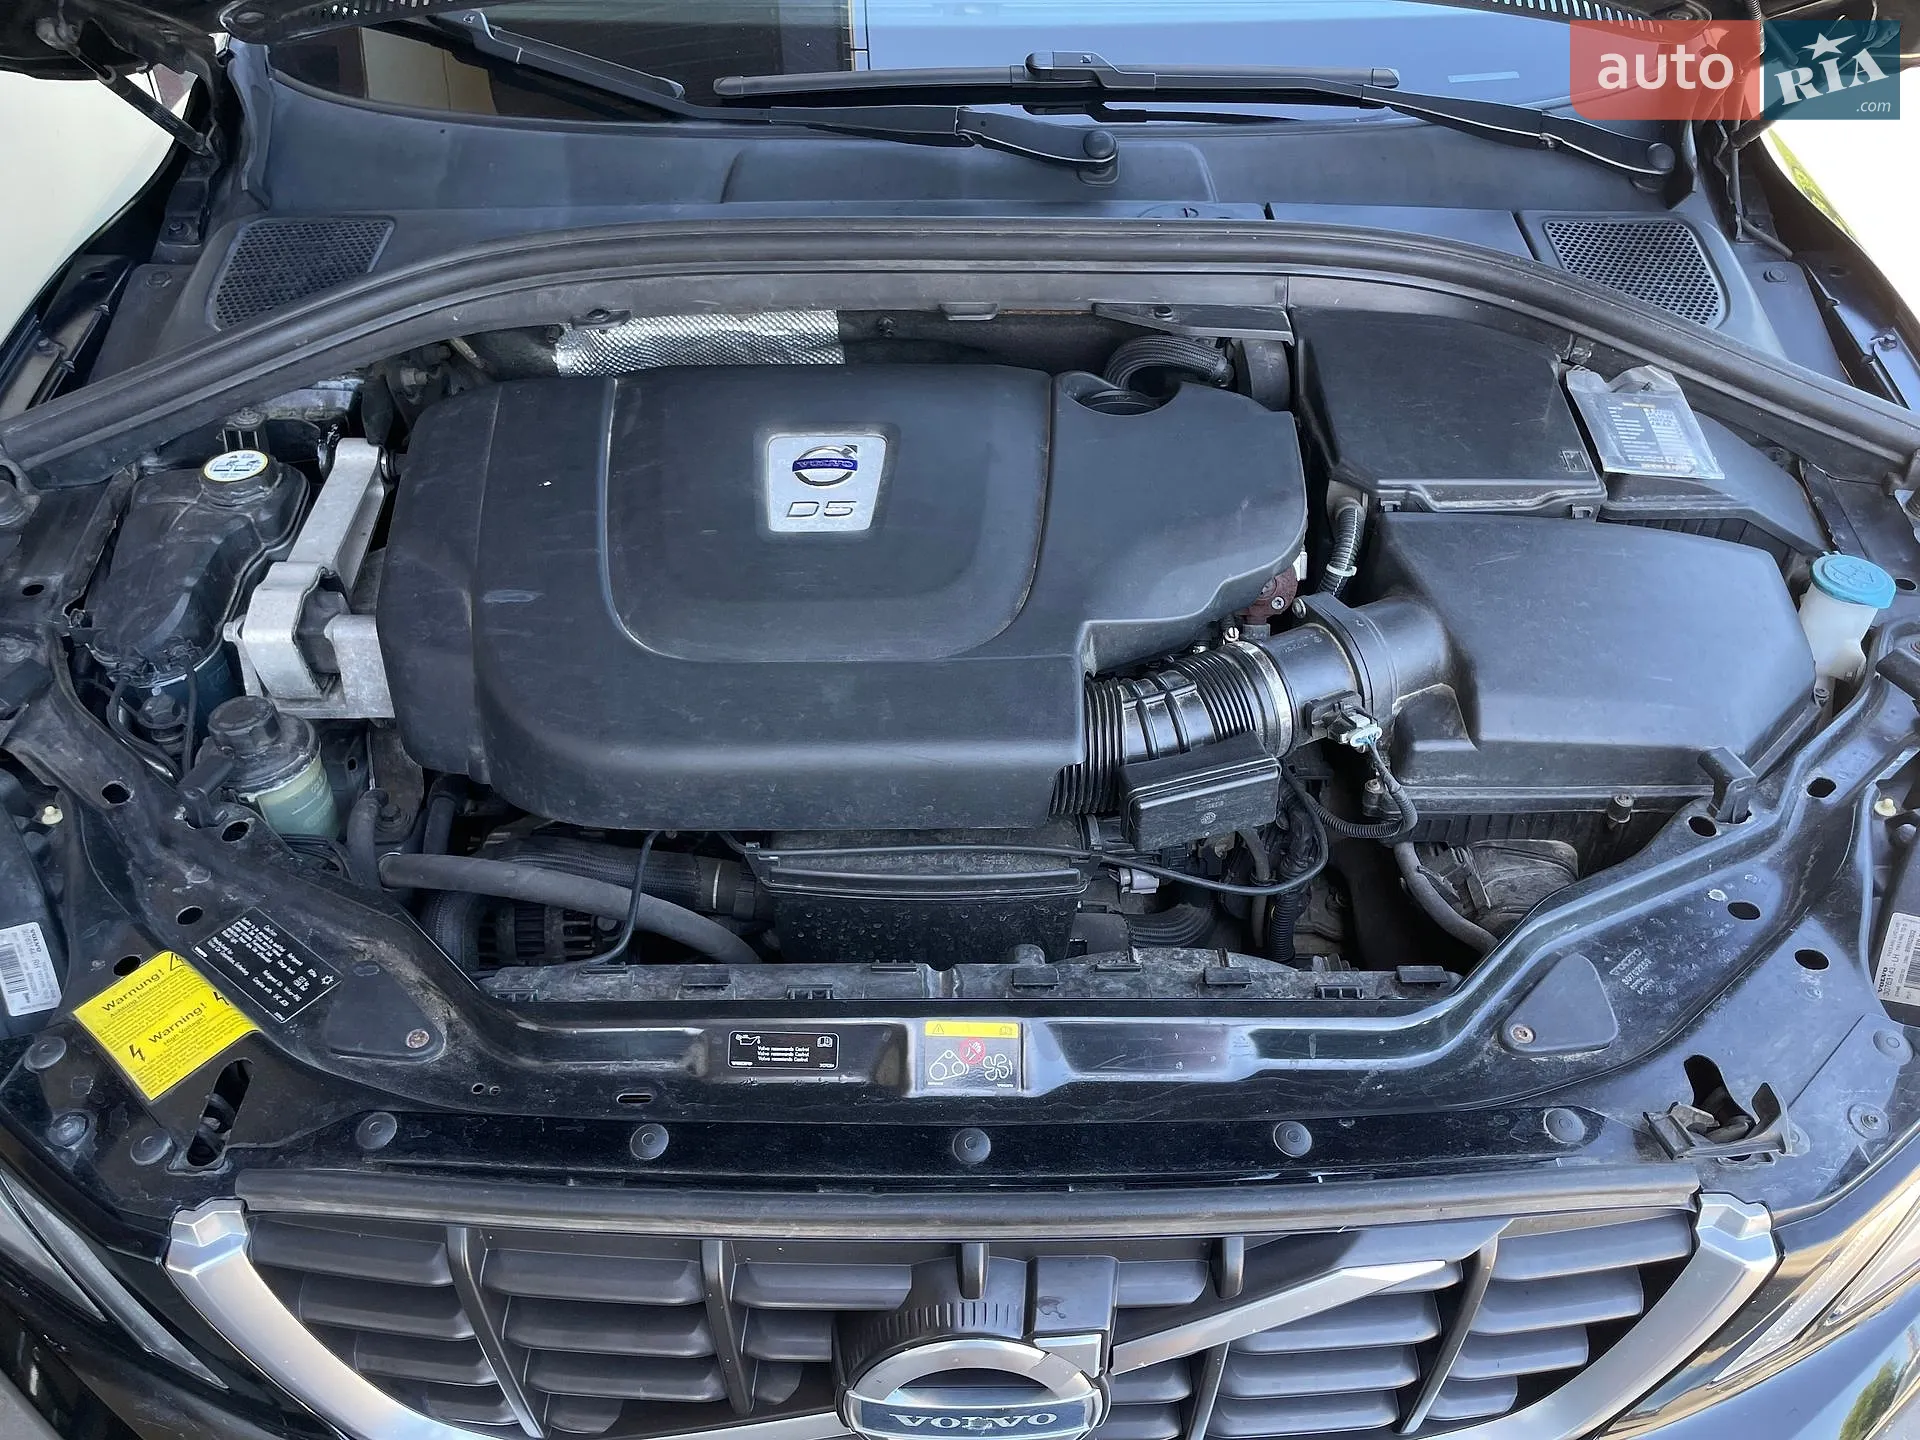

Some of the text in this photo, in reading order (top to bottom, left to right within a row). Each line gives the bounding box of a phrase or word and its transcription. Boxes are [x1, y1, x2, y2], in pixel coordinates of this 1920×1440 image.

[796, 460, 854, 468] VOLVO
[787, 501, 857, 517] D5
[1878, 967, 1888, 992] VOLVO
[102, 969, 165, 1011] Warnung!
[148, 1002, 207, 1044] Warning!
[889, 1413, 1057, 1428] VOLVO
